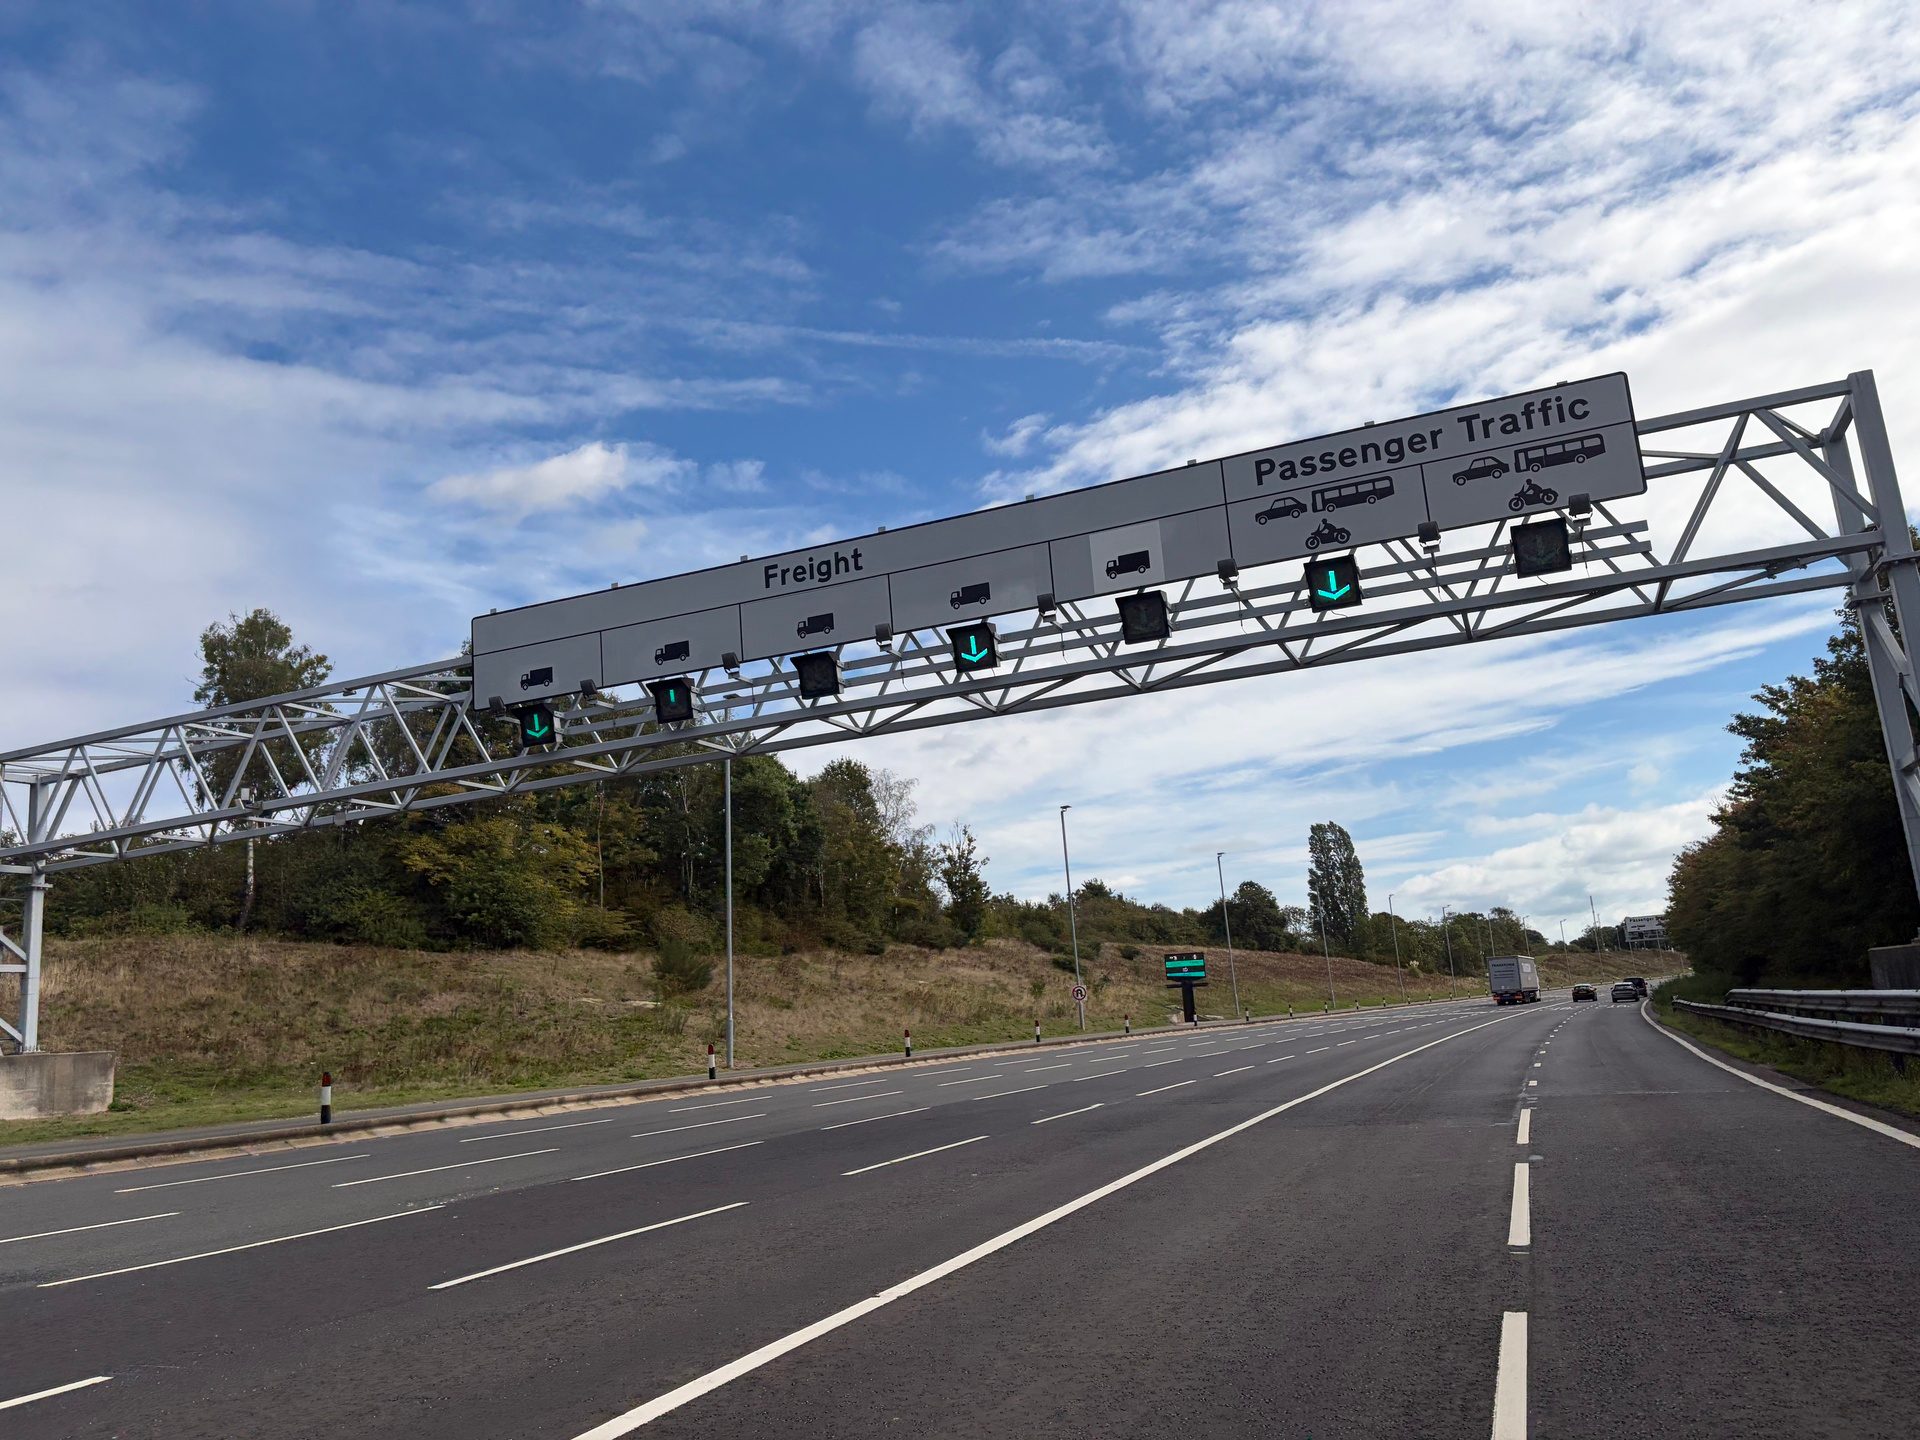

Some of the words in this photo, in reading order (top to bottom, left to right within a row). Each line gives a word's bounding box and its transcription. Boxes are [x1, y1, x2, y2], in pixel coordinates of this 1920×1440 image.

[1255, 427, 1443, 486] Passenger
[1457, 394, 1590, 442] Traffic
[764, 547, 863, 589] Freight
